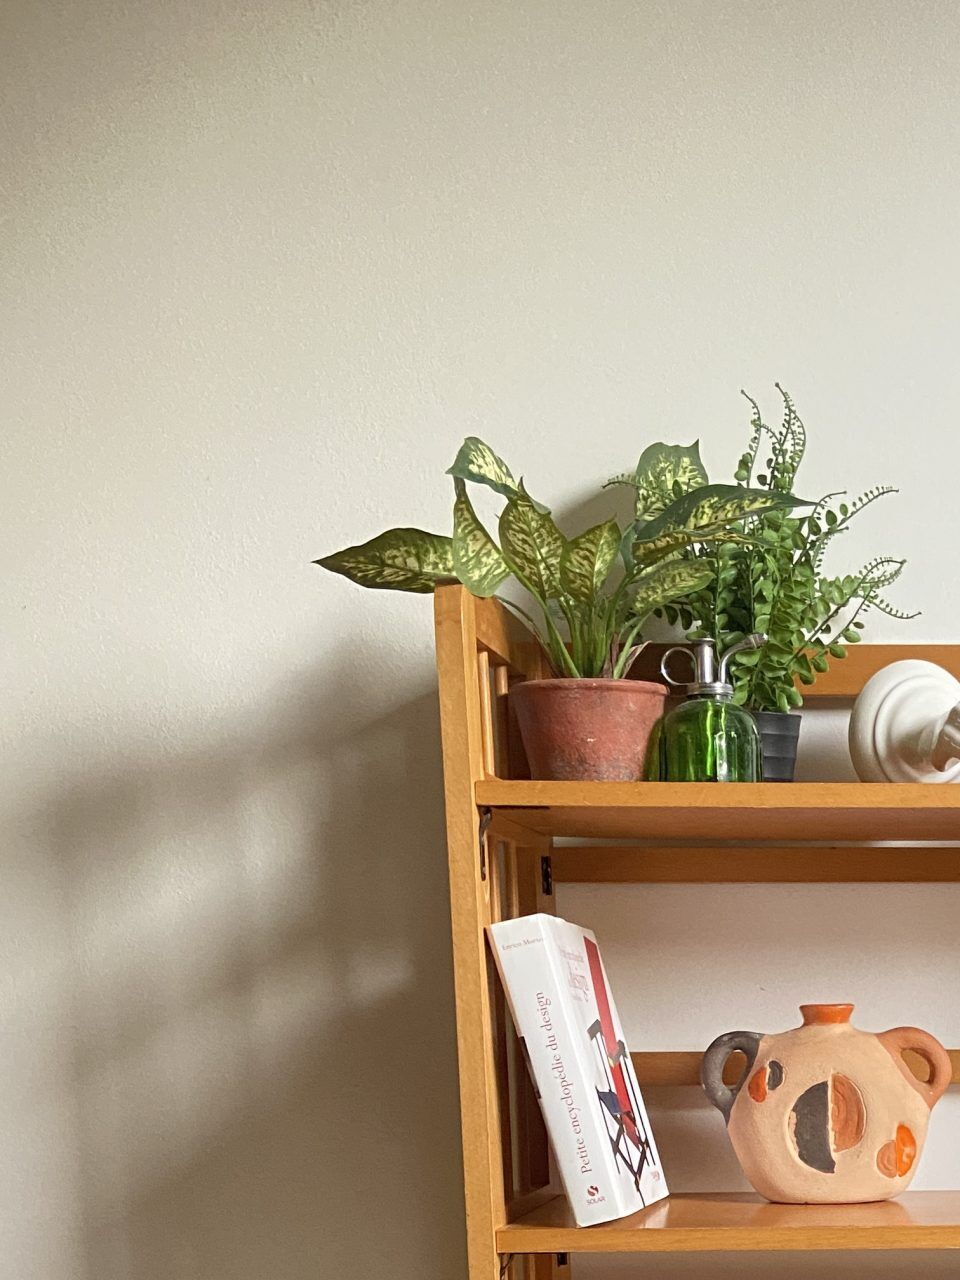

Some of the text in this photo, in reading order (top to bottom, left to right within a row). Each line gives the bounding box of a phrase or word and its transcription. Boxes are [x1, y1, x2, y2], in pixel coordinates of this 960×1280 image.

[536, 992, 592, 1174] Petite encyclopédie du design
[586, 1195, 606, 1205] SOLAR
